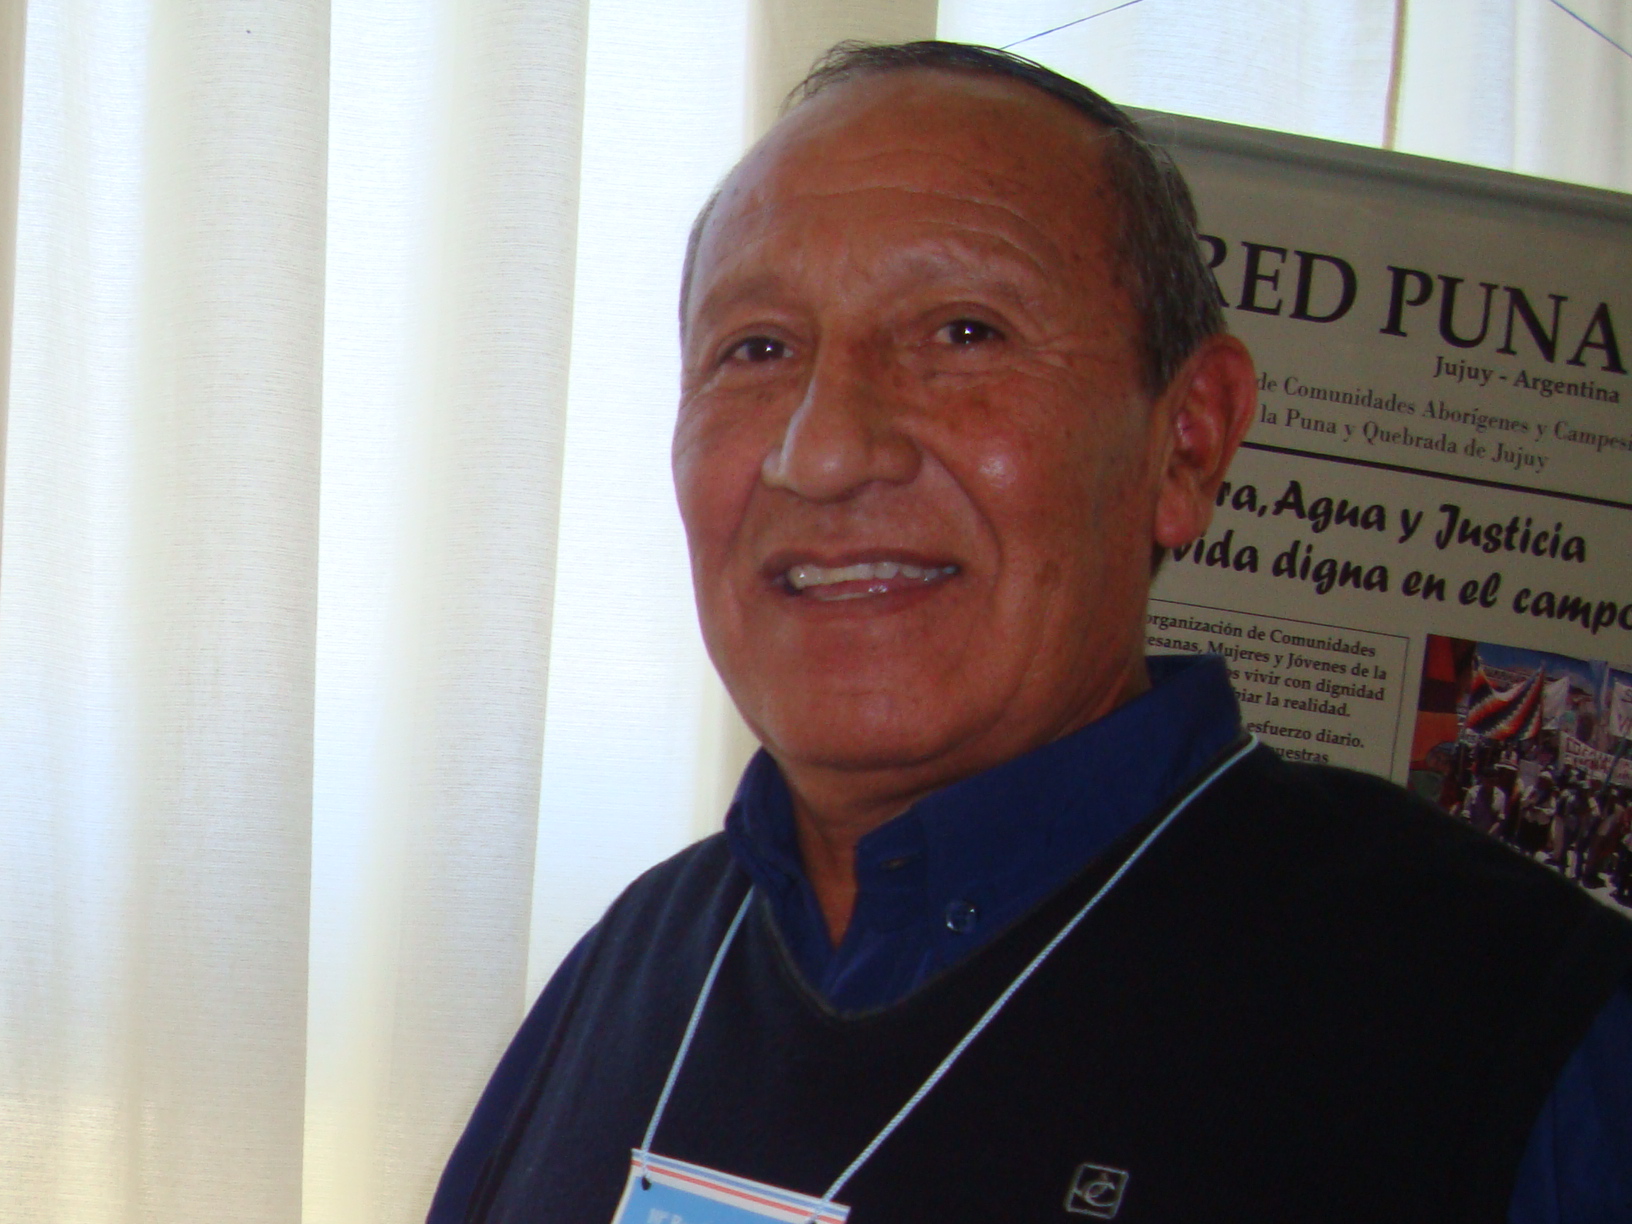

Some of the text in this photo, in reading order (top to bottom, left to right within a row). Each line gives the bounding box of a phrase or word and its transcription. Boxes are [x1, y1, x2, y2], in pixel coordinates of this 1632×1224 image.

[1197, 233, 1628, 375] RED PUNA
[1433, 355, 1495, 386] Jujuy
[1512, 370, 1620, 404] Argentina
[1256, 372, 1277, 392] de
[1283, 376, 1416, 415] Comunidades
[1422, 400, 1529, 434] Aborígenes
[1533, 423, 1547, 442] y
[1260, 404, 1549, 473] la Puna y Quebrada de Jujuy
[1272, 480, 1386, 533] Agua
[1398, 508, 1424, 544] y
[1435, 503, 1586, 563] Justicia
[1272, 540, 1388, 594] digna
[1402, 571, 1446, 601] en
[1458, 572, 1502, 608] el
[1512, 588, 1632, 635] campo
[1146, 635, 1387, 680] esanas, Mujeres y Jóvenes de la
[1247, 625, 1266, 640] de
[1270, 629, 1376, 657] Comunidades
[1244, 669, 1281, 685] vivir
[1284, 676, 1311, 690] con
[1316, 678, 1385, 700] dignidad
[1266, 692, 1279, 706] la
[1283, 697, 1350, 717] realidad.
[1247, 721, 1364, 748] esfuerzo diario.
[1273, 746, 1329, 763] uestras
